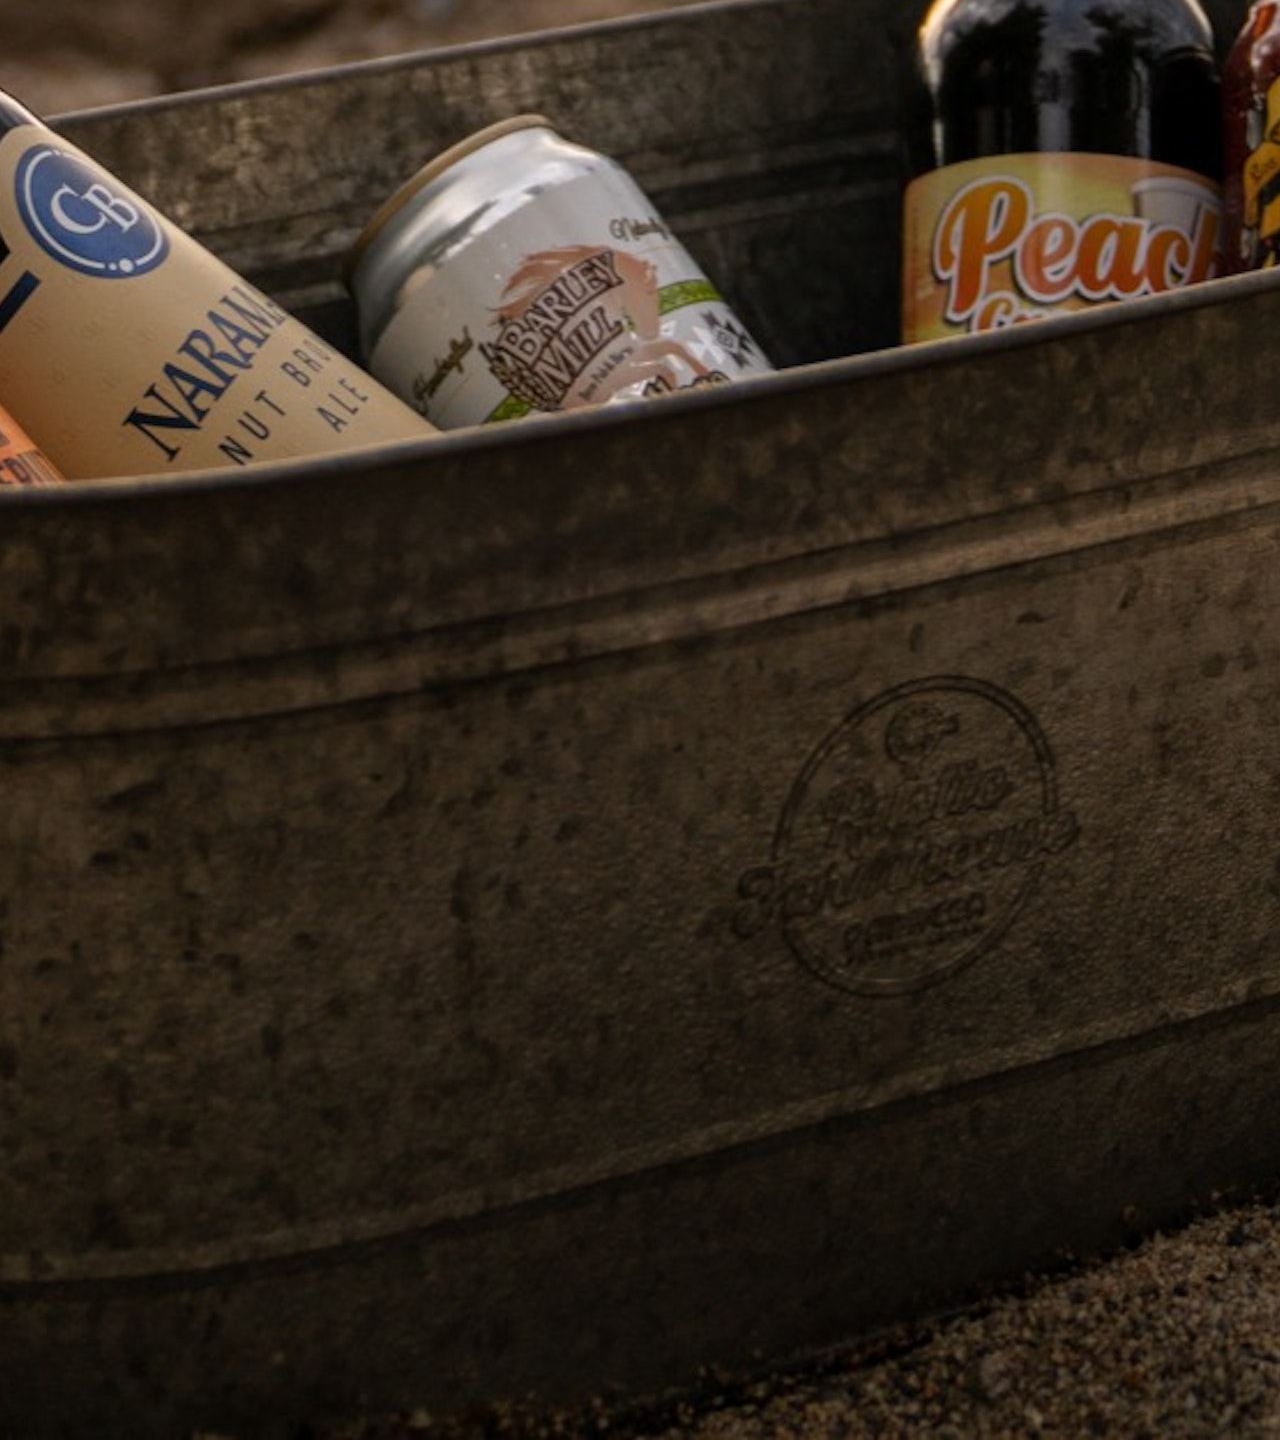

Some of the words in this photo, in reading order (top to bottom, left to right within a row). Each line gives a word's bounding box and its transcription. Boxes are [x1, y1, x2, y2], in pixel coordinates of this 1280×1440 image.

[50, 183, 139, 234] CB
[498, 248, 625, 365] BARLEY
[533, 305, 624, 401] MILL
[218, 390, 286, 466] NUT
[316, 377, 368, 433] ALE
